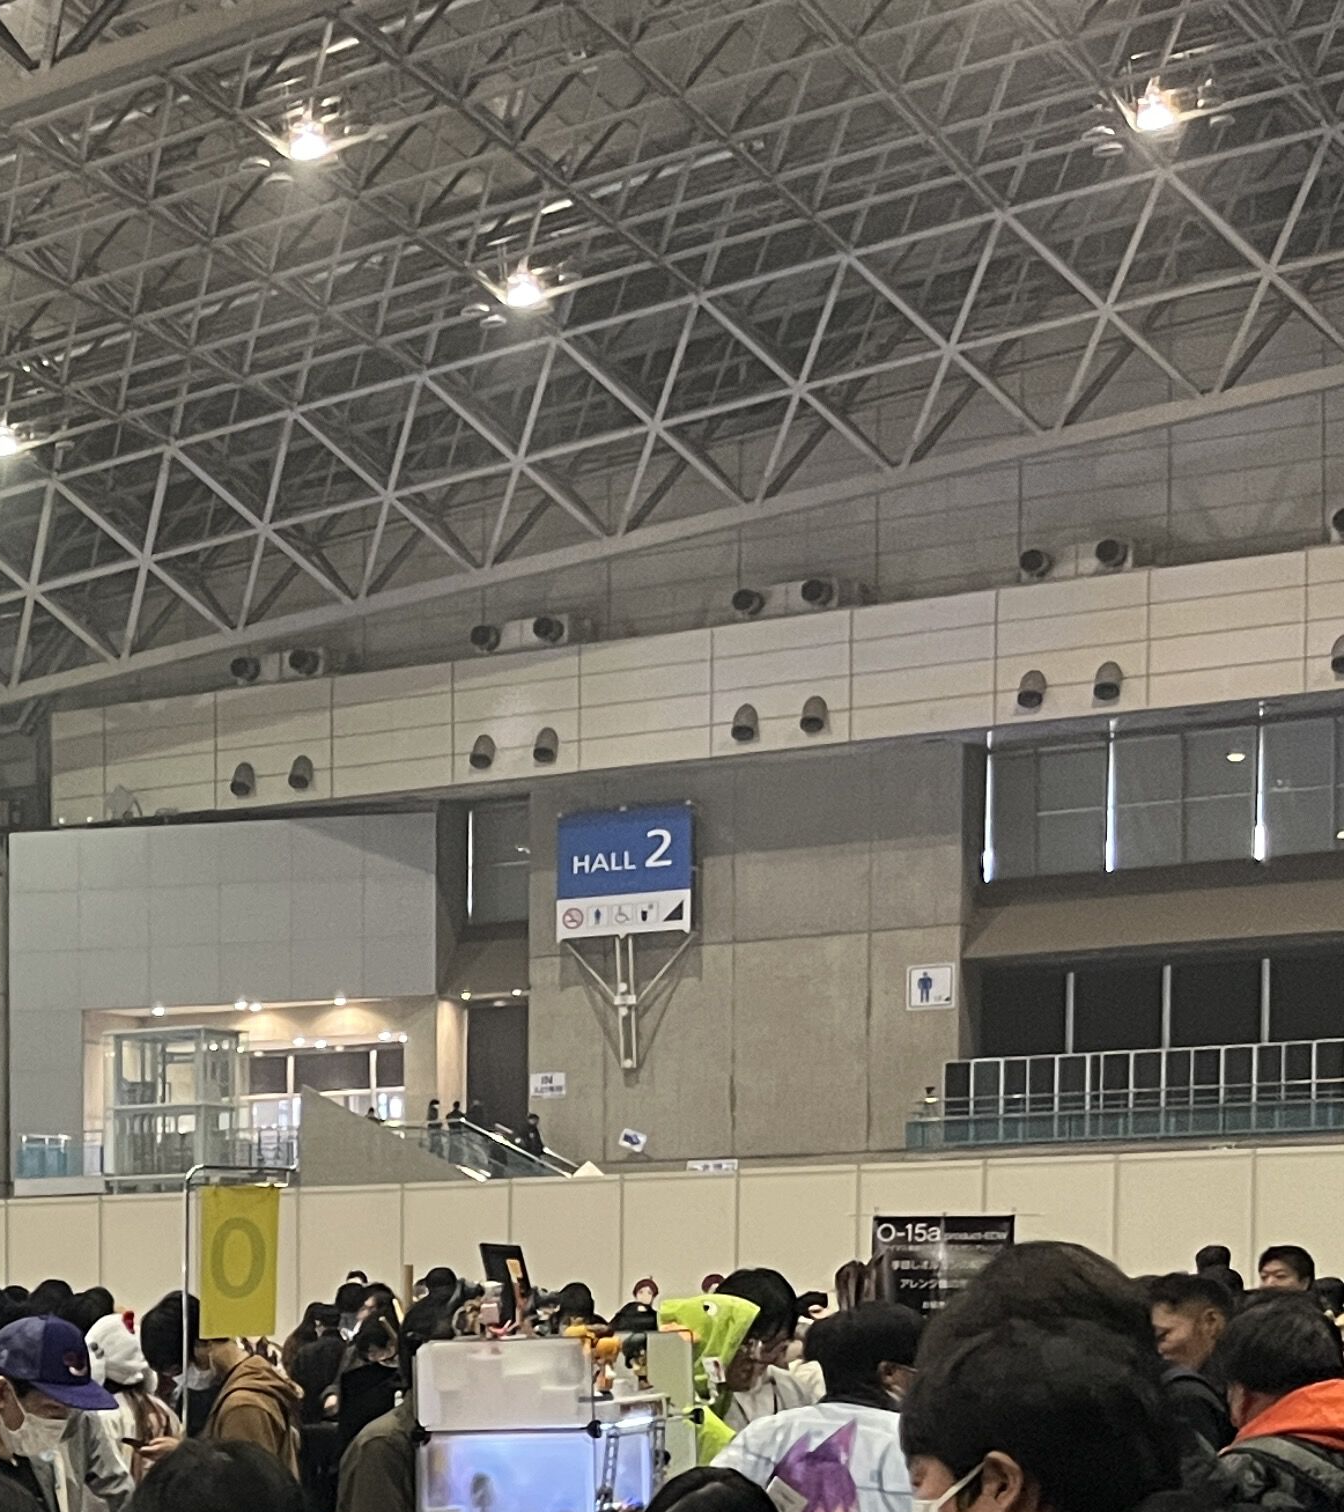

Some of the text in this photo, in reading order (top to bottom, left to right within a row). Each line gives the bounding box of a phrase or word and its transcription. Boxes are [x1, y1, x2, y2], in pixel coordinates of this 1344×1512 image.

[573, 828, 673, 875] HALL 2
[877, 1223, 941, 1242] O-15a
